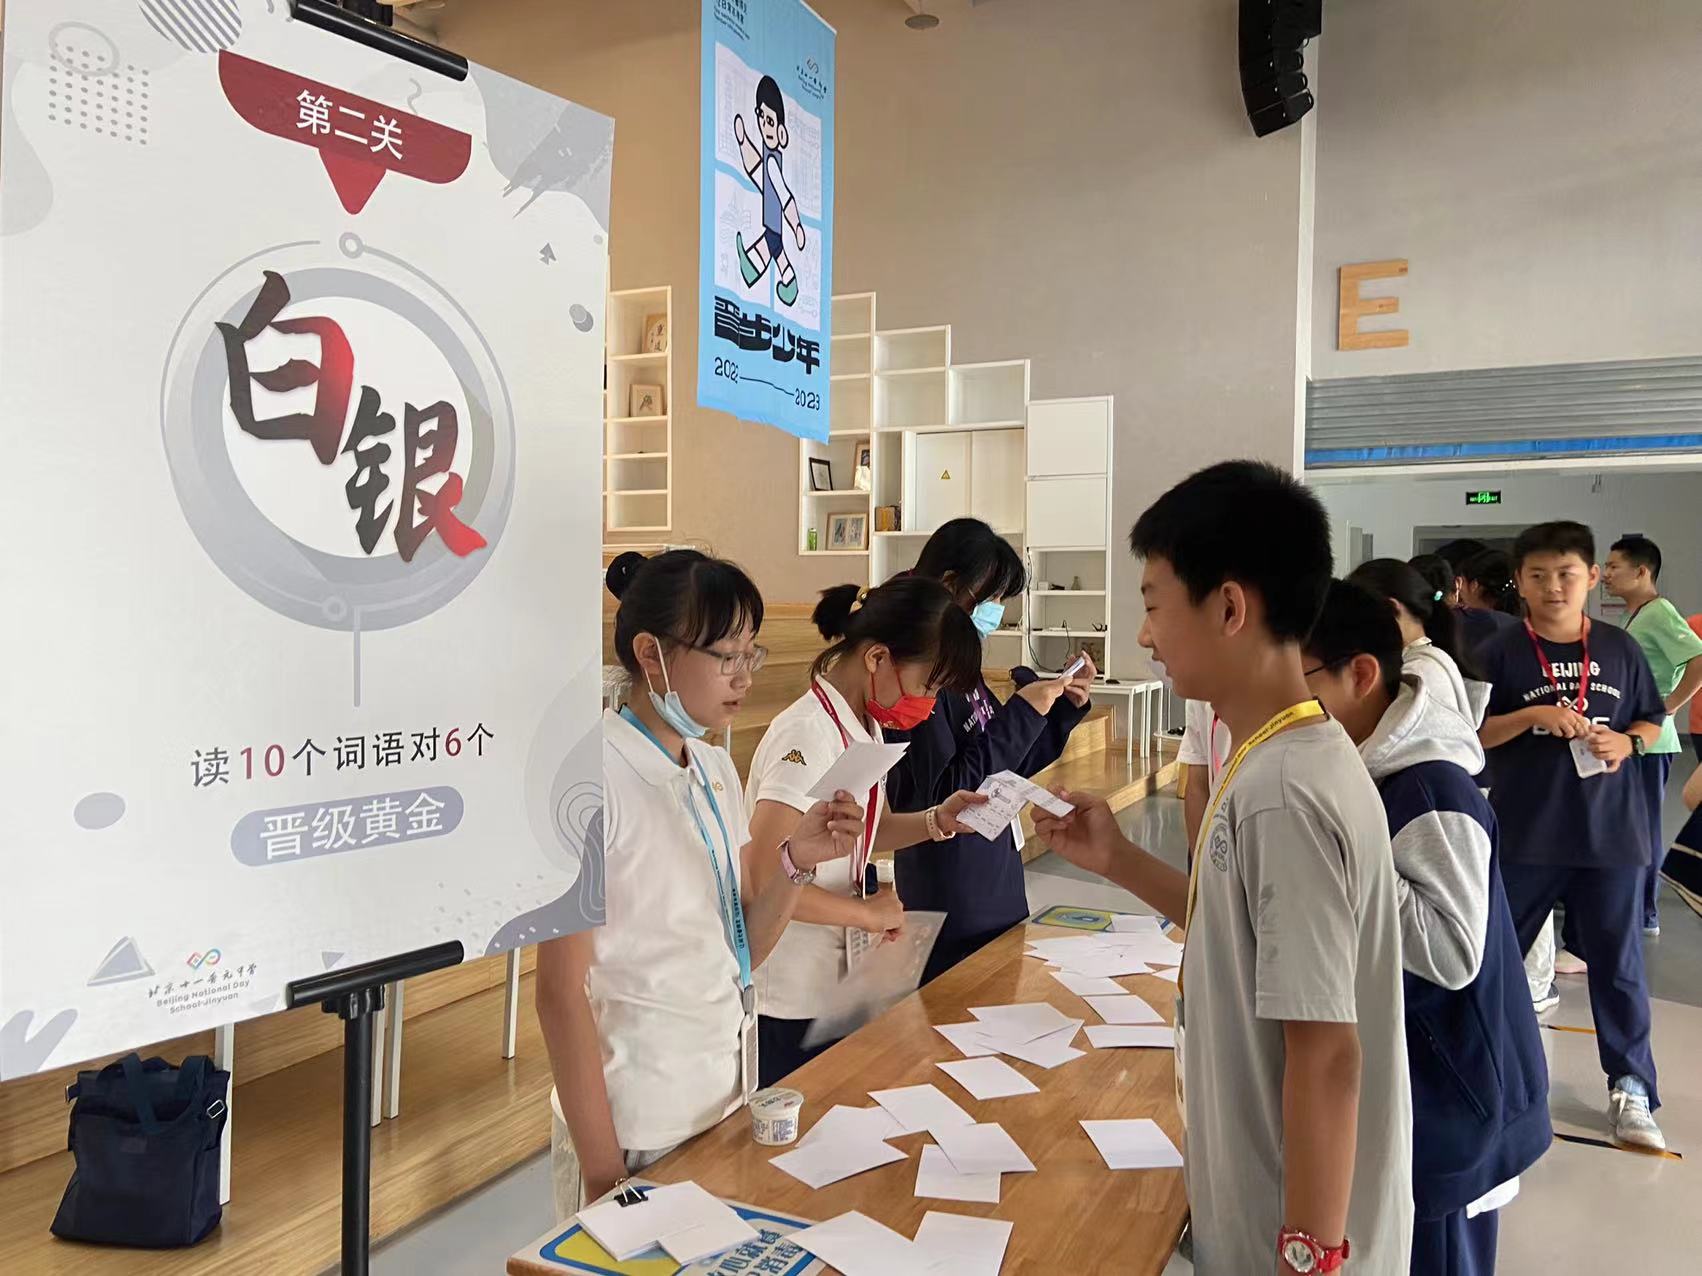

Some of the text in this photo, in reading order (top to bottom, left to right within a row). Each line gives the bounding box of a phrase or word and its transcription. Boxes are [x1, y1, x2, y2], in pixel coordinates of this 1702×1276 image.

[296, 89, 404, 160] 第二关
[1337, 259, 1408, 351] E
[214, 270, 487, 562] 白银
[1590, 681, 1621, 699] SCHOOL
[190, 722, 495, 788] 读10个词语对6个
[259, 791, 446, 860] 晋级黄金
[156, 979, 250, 1007] Beijing National Day
